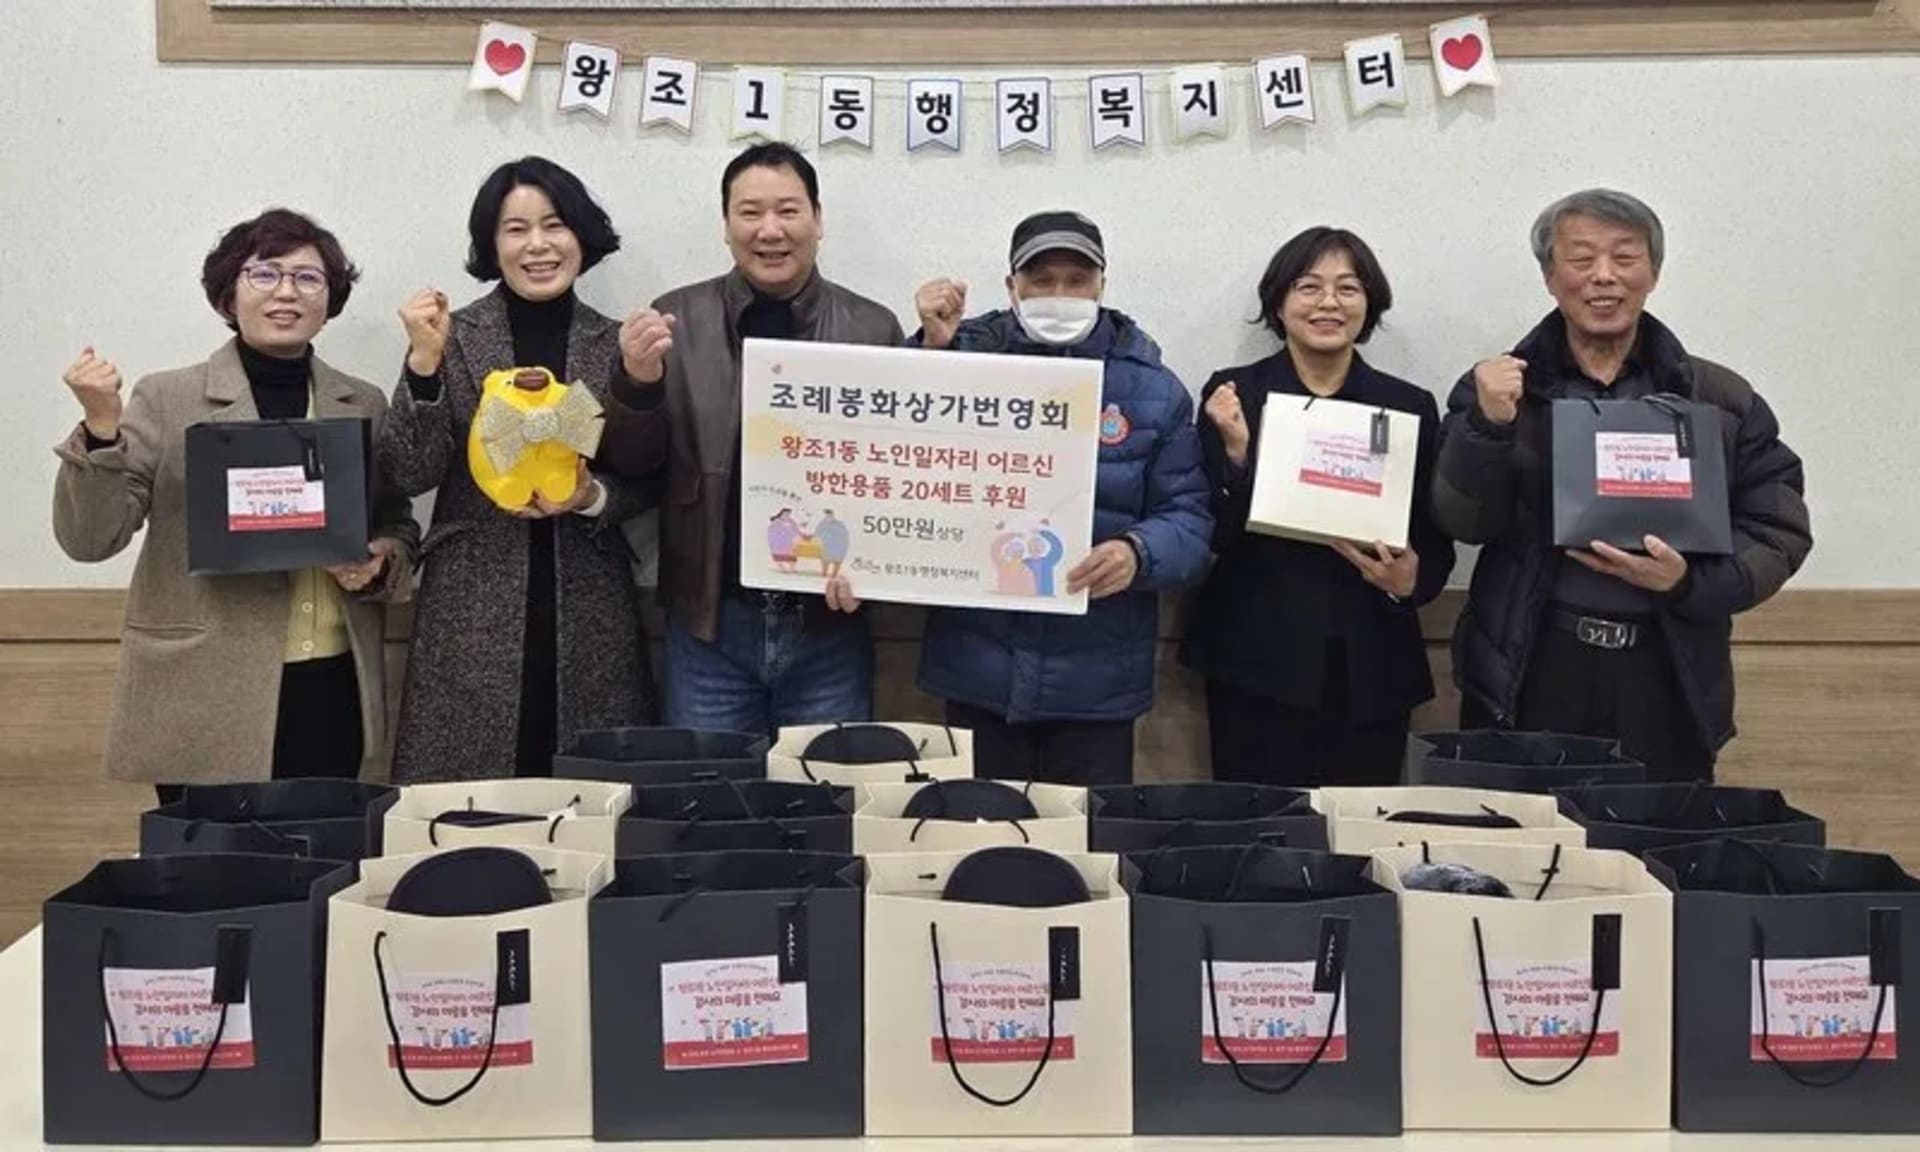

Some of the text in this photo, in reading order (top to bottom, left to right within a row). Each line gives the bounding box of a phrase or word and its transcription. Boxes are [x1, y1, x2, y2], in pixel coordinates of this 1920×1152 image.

[769, 382, 1070, 431] 조례봉화상가번영회
[781, 435, 1054, 478] 왕조1동 노인일자리 어르신
[805, 469, 893, 500] 방한용품
[900, 479, 974, 505] 20세트
[981, 481, 1027, 510] 후원
